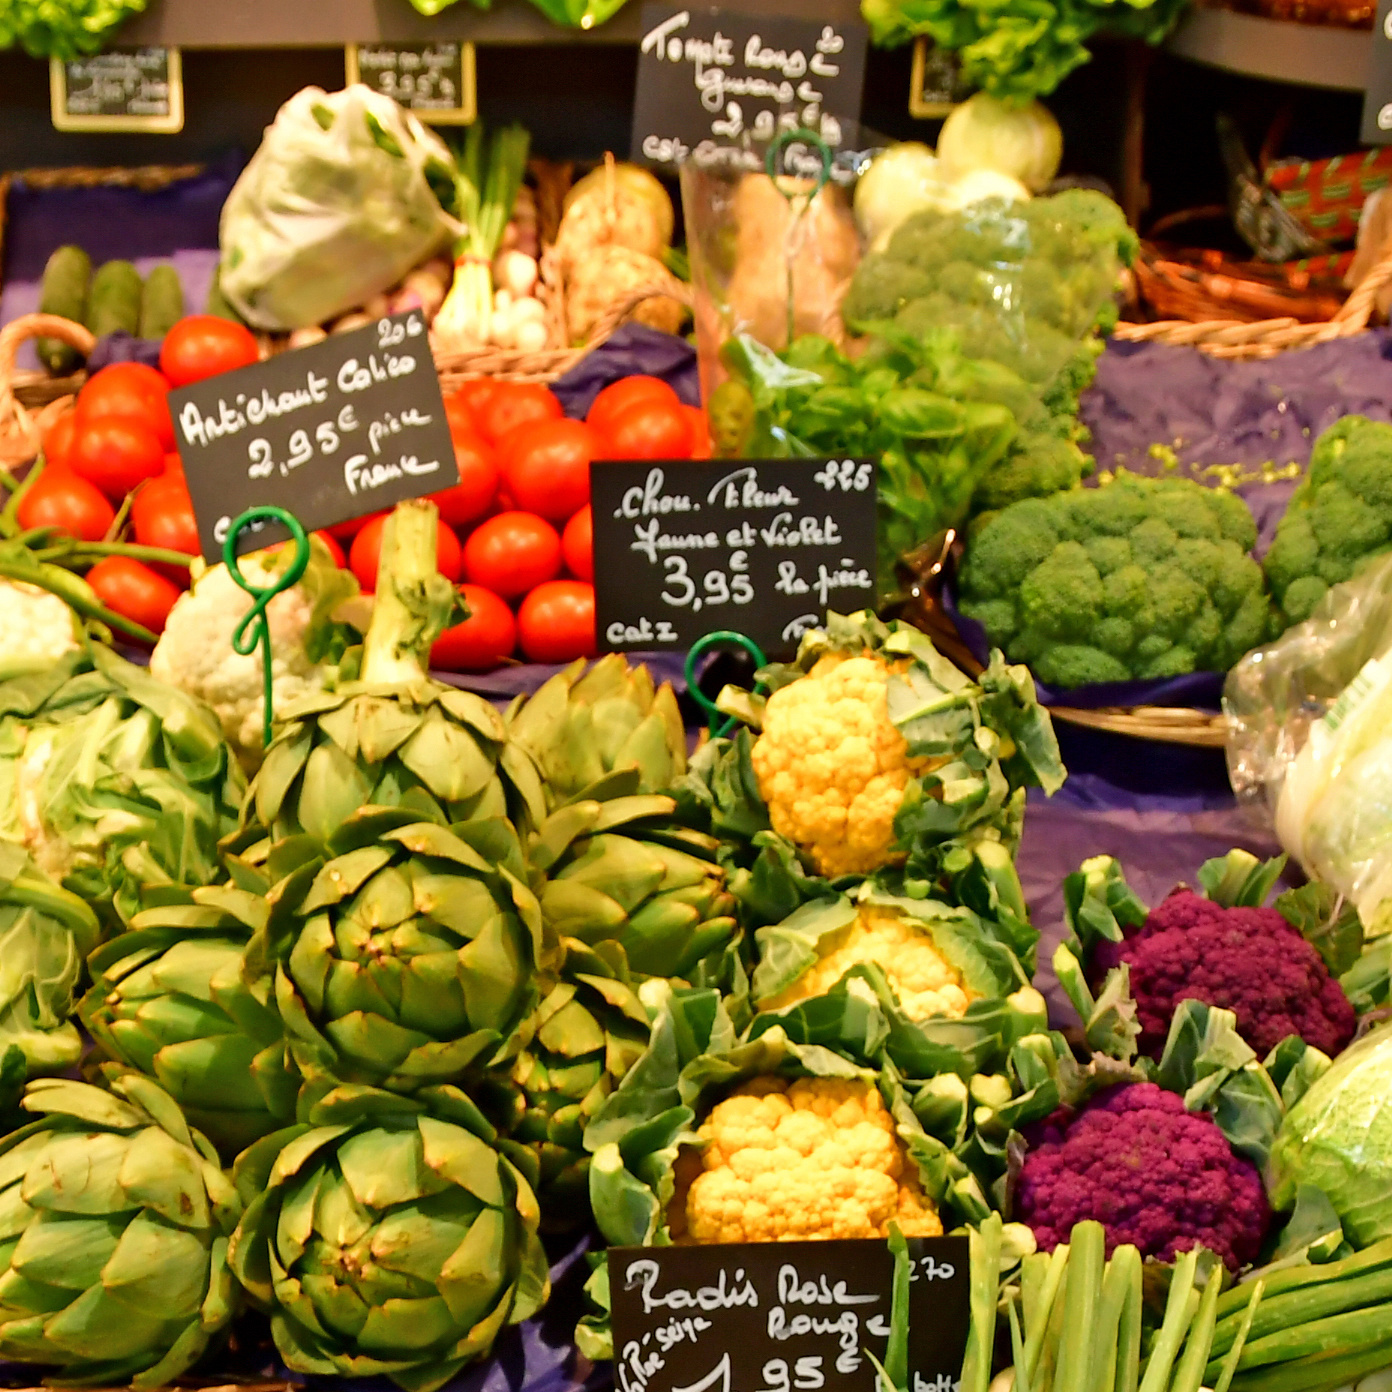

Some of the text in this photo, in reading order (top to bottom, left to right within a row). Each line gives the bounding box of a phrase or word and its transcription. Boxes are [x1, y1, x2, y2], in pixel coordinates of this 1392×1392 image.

[343, 453, 441, 496] France
[725, 520, 759, 548] et
[623, 1259, 759, 1315] Radis
